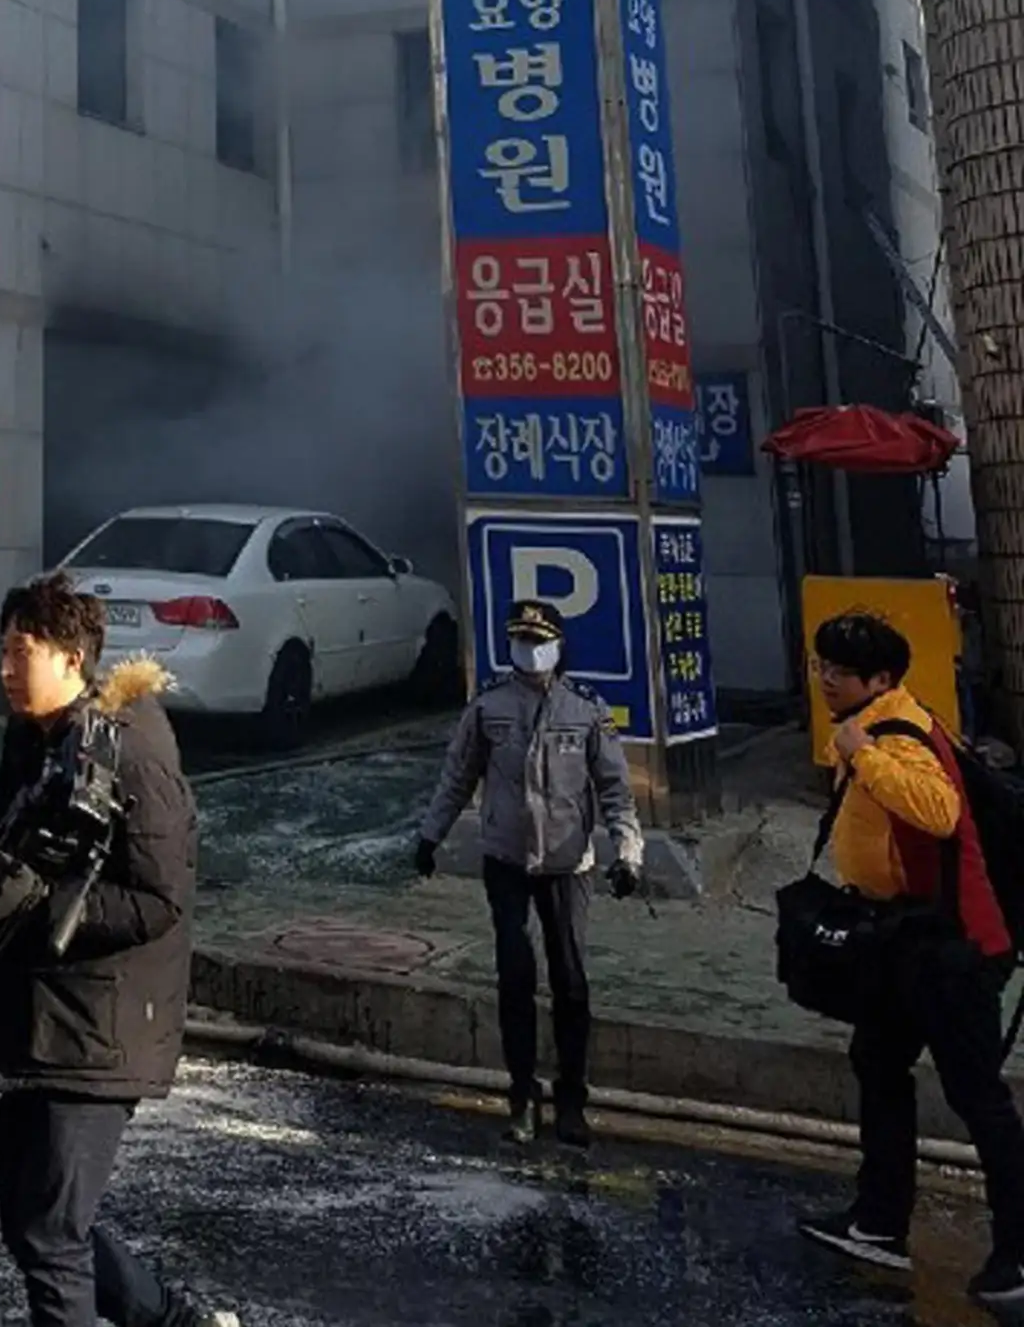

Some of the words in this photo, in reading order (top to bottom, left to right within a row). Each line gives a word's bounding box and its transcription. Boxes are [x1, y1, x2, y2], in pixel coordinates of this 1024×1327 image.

[467, 252, 605, 336] 응급실
[494, 352, 612, 382] 356-8200
[476, 412, 616, 483] 장례식장
[511, 547, 600, 619] P
